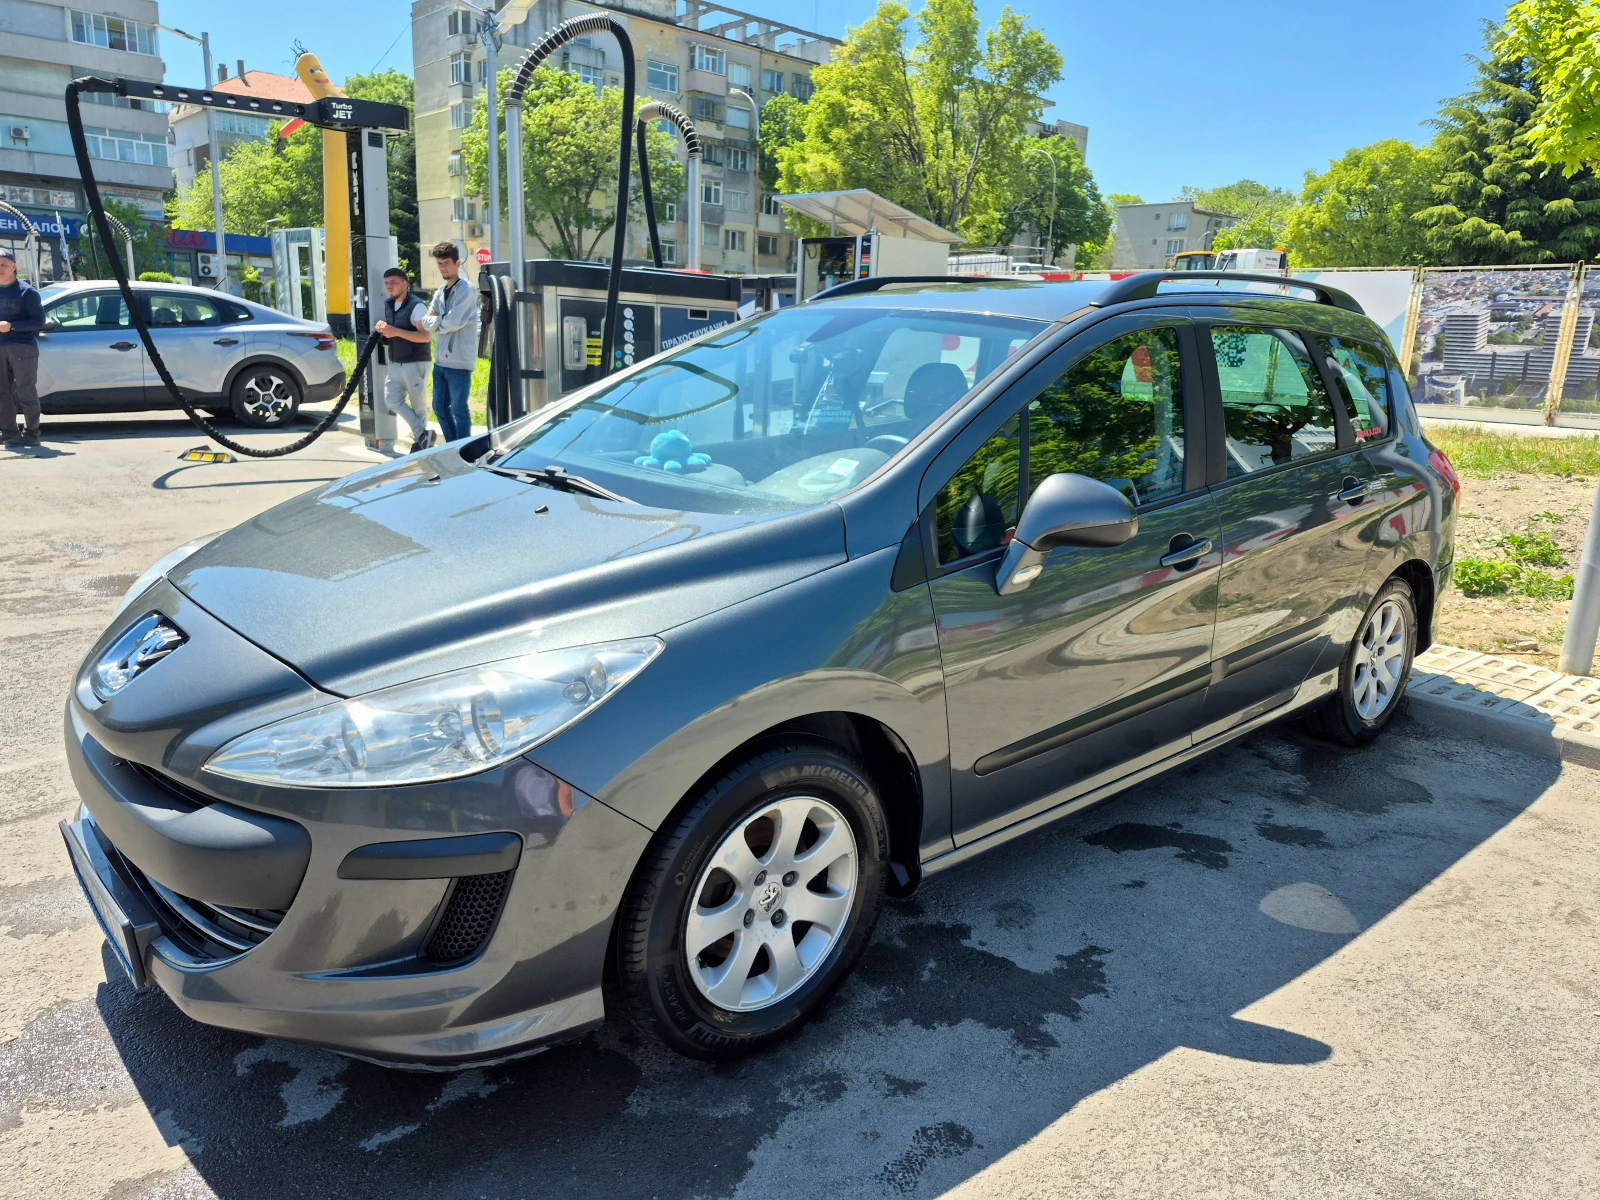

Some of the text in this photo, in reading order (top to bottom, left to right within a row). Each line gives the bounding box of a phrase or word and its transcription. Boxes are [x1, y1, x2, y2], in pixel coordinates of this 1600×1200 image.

[331, 102, 352, 110] Turbo
[332, 110, 352, 119] JET
[477, 253, 492, 262] STOP
[661, 320, 729, 349] ПРАХОСМУКАЧКА
[801, 764, 866, 797] MICHELIN
[664, 981, 690, 1021] PRIMACY
